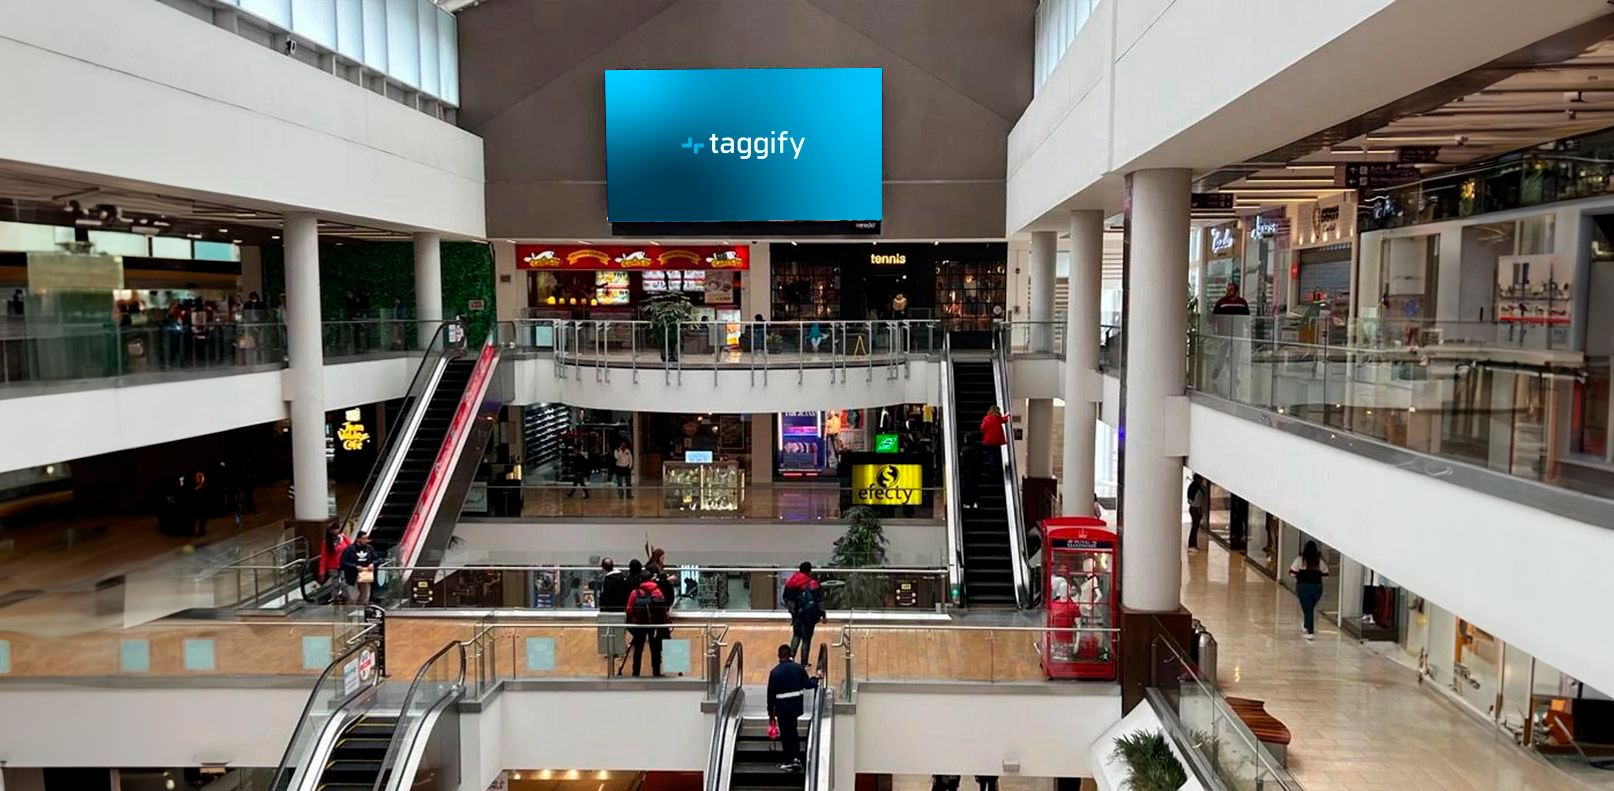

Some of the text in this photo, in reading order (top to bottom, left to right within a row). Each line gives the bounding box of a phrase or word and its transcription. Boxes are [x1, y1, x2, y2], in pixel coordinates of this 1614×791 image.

[709, 131, 806, 160] taggify
[870, 253, 906, 265] tennis
[858, 483, 913, 505] efecty
